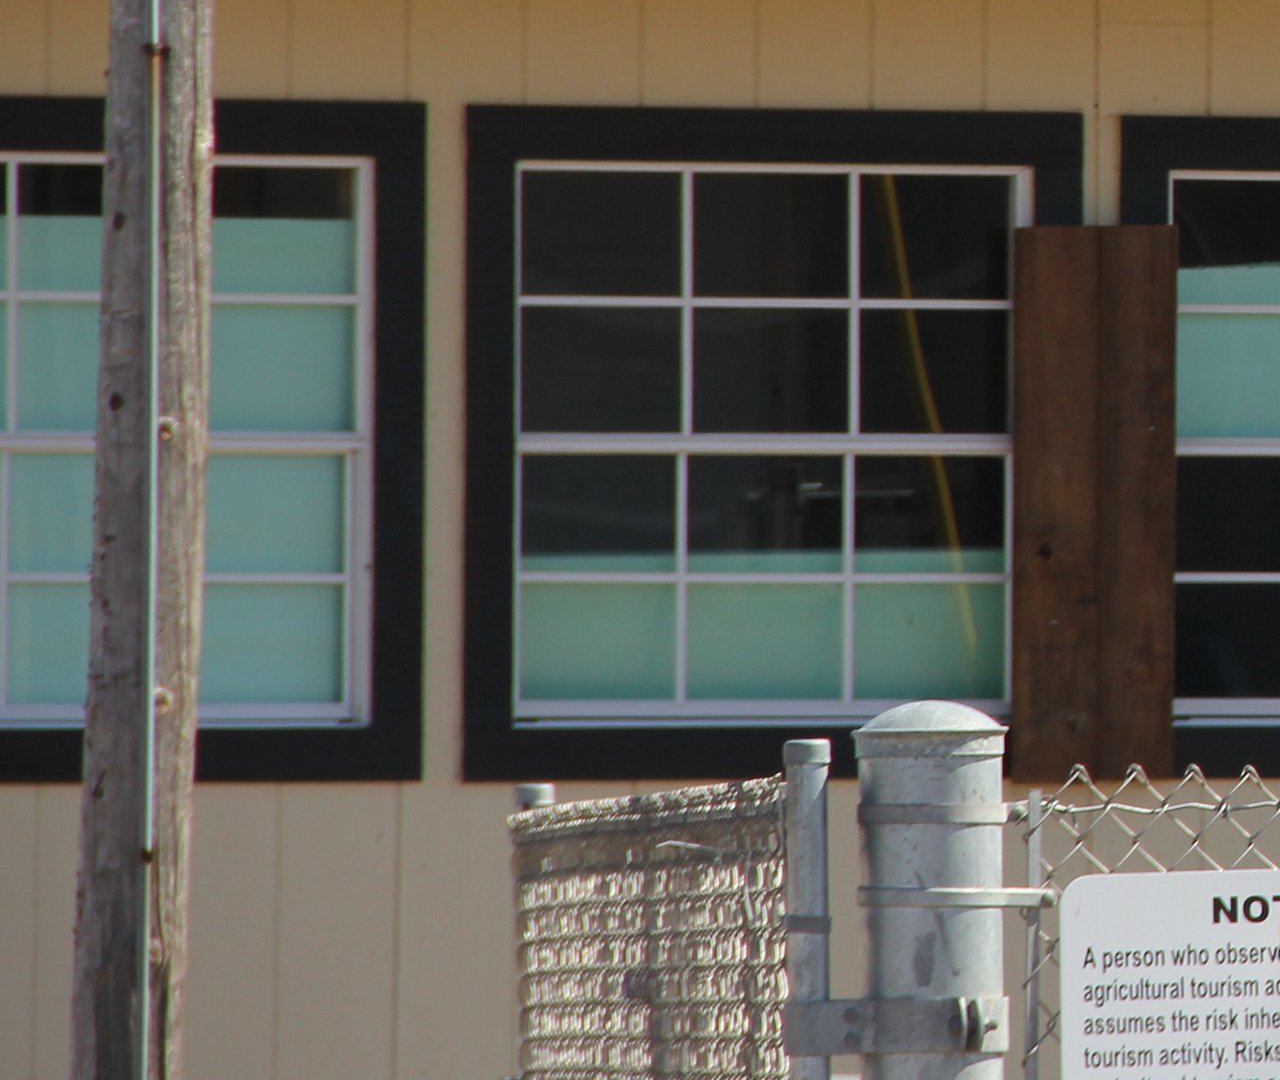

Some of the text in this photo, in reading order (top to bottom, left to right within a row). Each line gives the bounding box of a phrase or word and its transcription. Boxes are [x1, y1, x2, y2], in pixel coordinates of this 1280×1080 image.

[1082, 946, 1097, 969] A
[1102, 949, 1166, 974] person
[1171, 943, 1210, 967] who
[1083, 976, 1185, 1009] agricultural
[1189, 975, 1259, 999] tourism
[1083, 1015, 1166, 1036] assumes
[1171, 1011, 1200, 1033] the
[1205, 1008, 1239, 1031] risk
[1083, 1044, 1154, 1069] tourism
[1159, 1042, 1229, 1070] activity.
